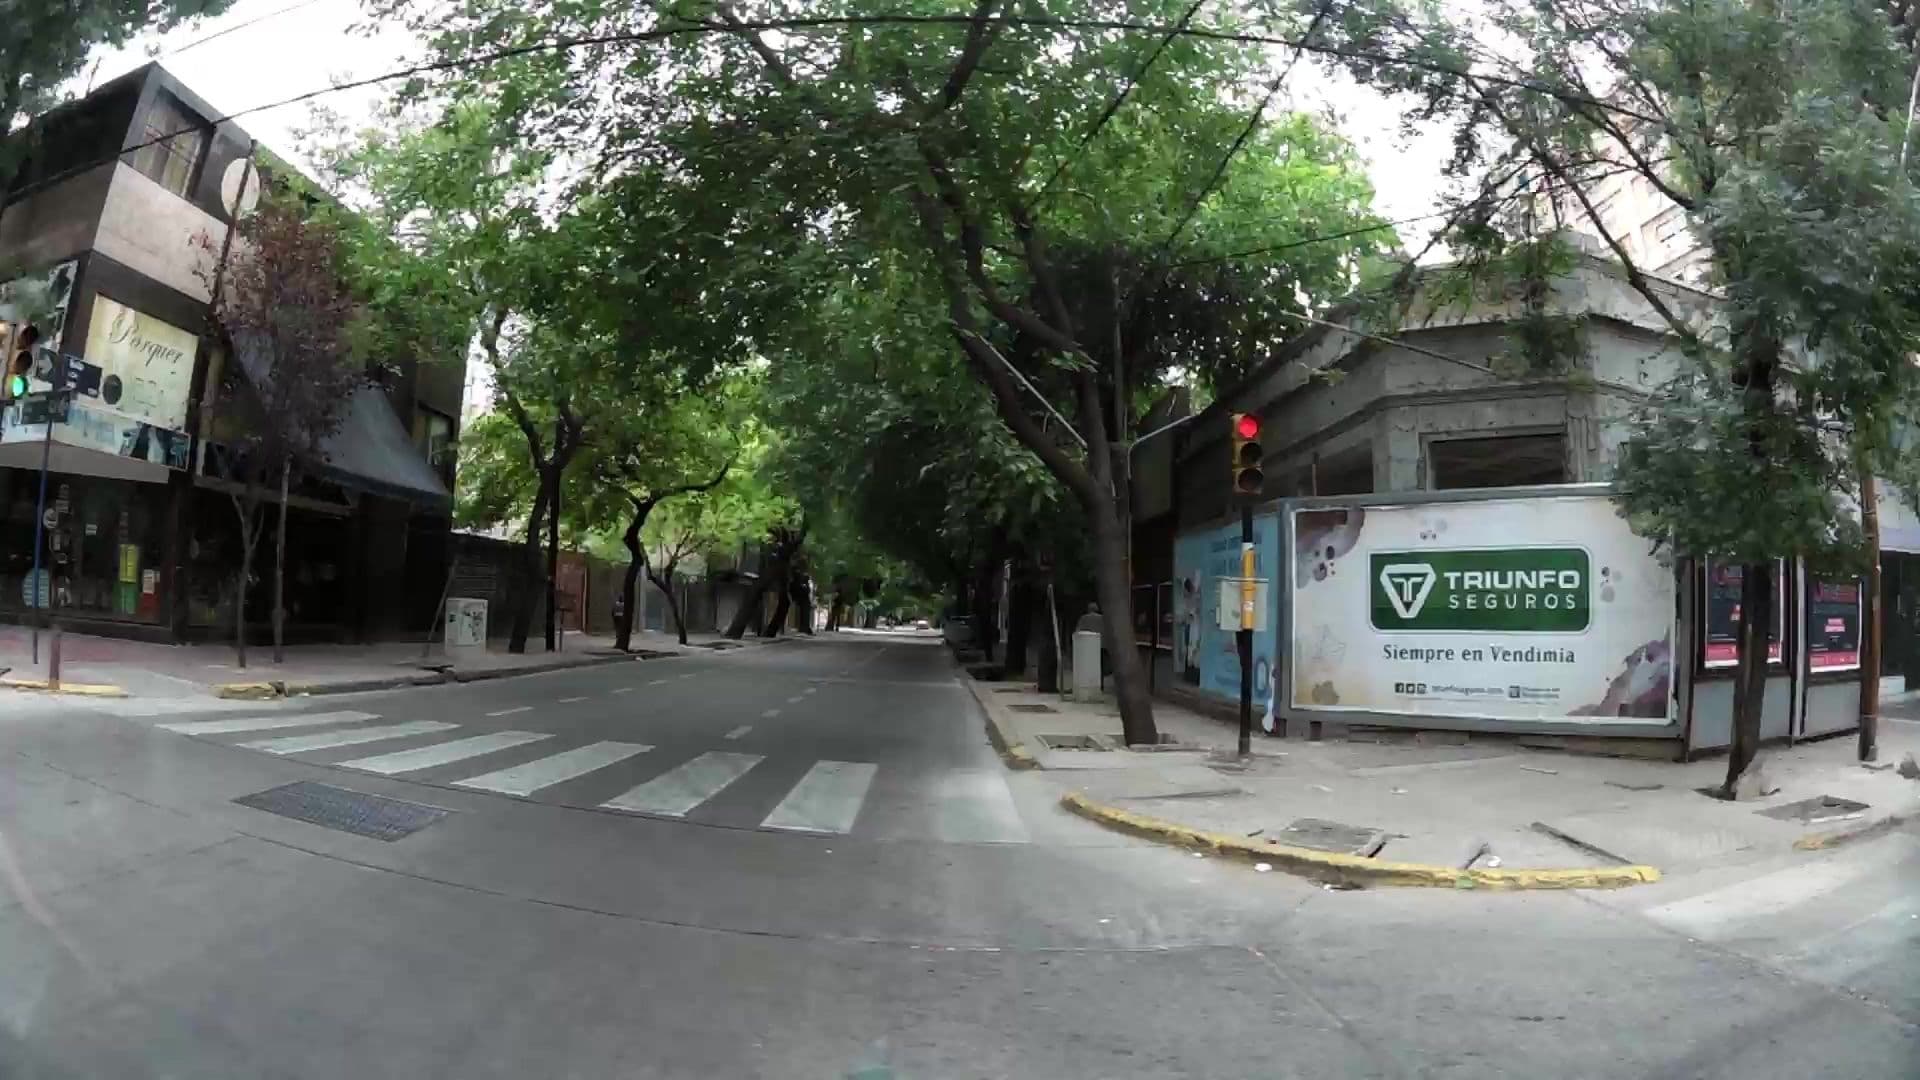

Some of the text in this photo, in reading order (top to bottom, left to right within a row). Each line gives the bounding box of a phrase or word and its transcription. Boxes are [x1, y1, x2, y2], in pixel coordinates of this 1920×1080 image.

[1443, 570, 1581, 590] TRIUNFO
[1448, 593, 1577, 610] SEGUROS
[1383, 644, 1576, 664] Siempre en Vendimia
